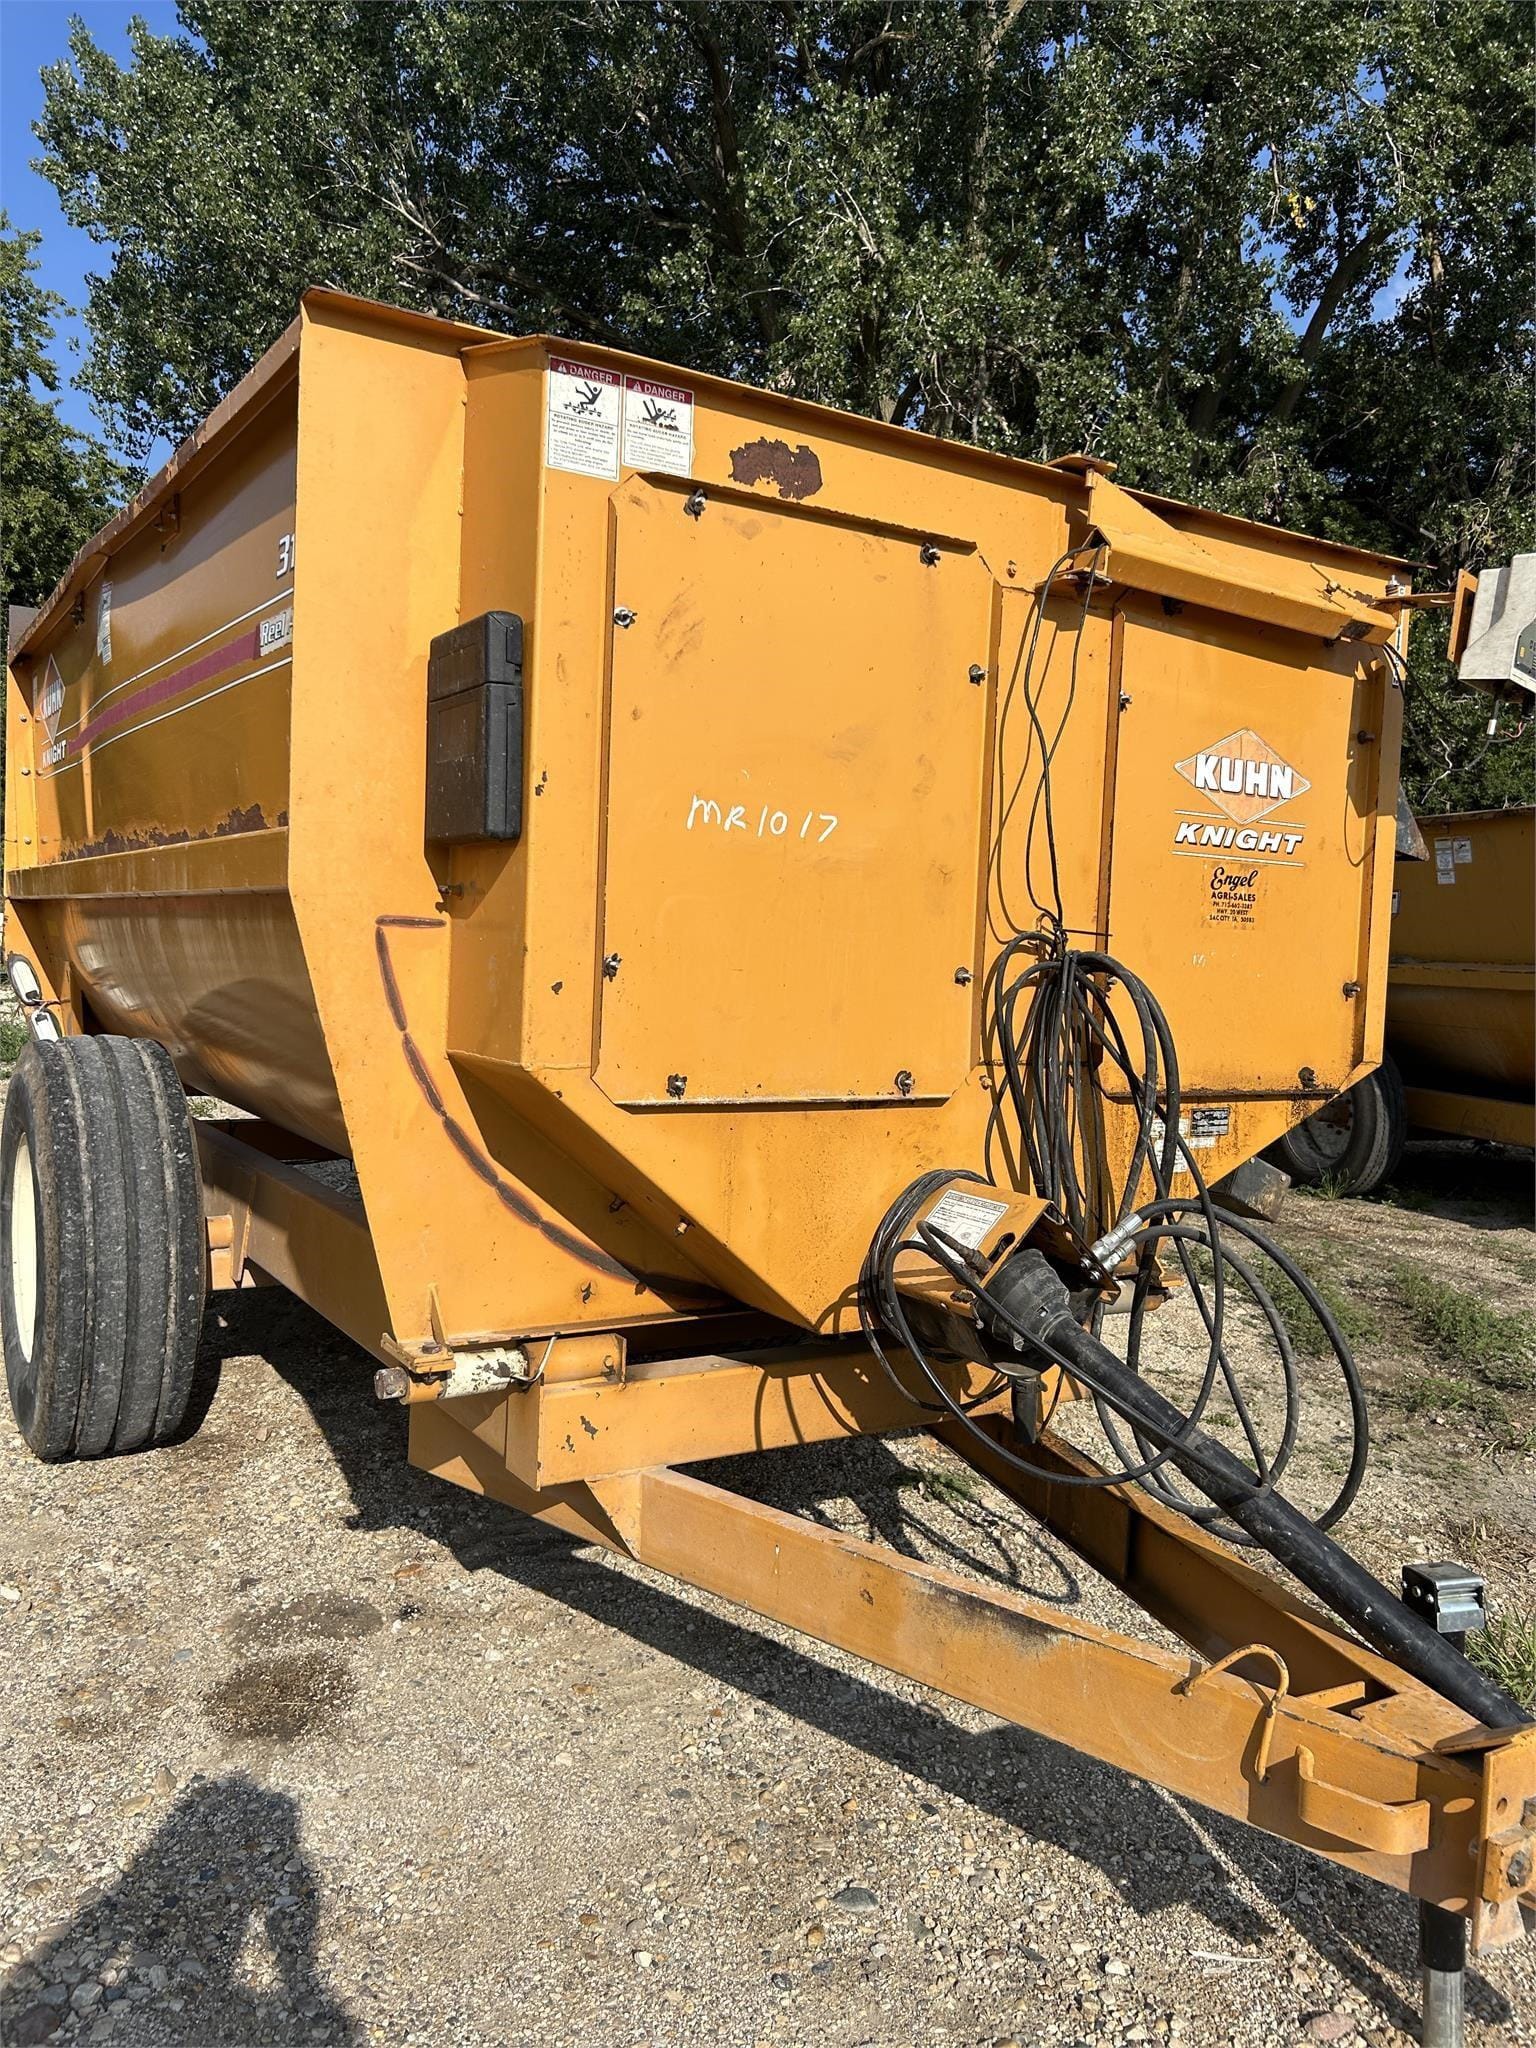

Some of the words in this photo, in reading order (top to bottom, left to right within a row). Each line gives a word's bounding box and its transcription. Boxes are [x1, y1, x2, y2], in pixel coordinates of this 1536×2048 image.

[569, 365, 613, 384] DANGER
[644, 384, 686, 402] DANGER
[260, 612, 287, 648] Reel
[1194, 754, 1293, 799] KUHN
[1175, 822, 1303, 855] KNIGHT
[1210, 866, 1258, 892] Engel
[1211, 891, 1256, 901] AGRI-SALES
